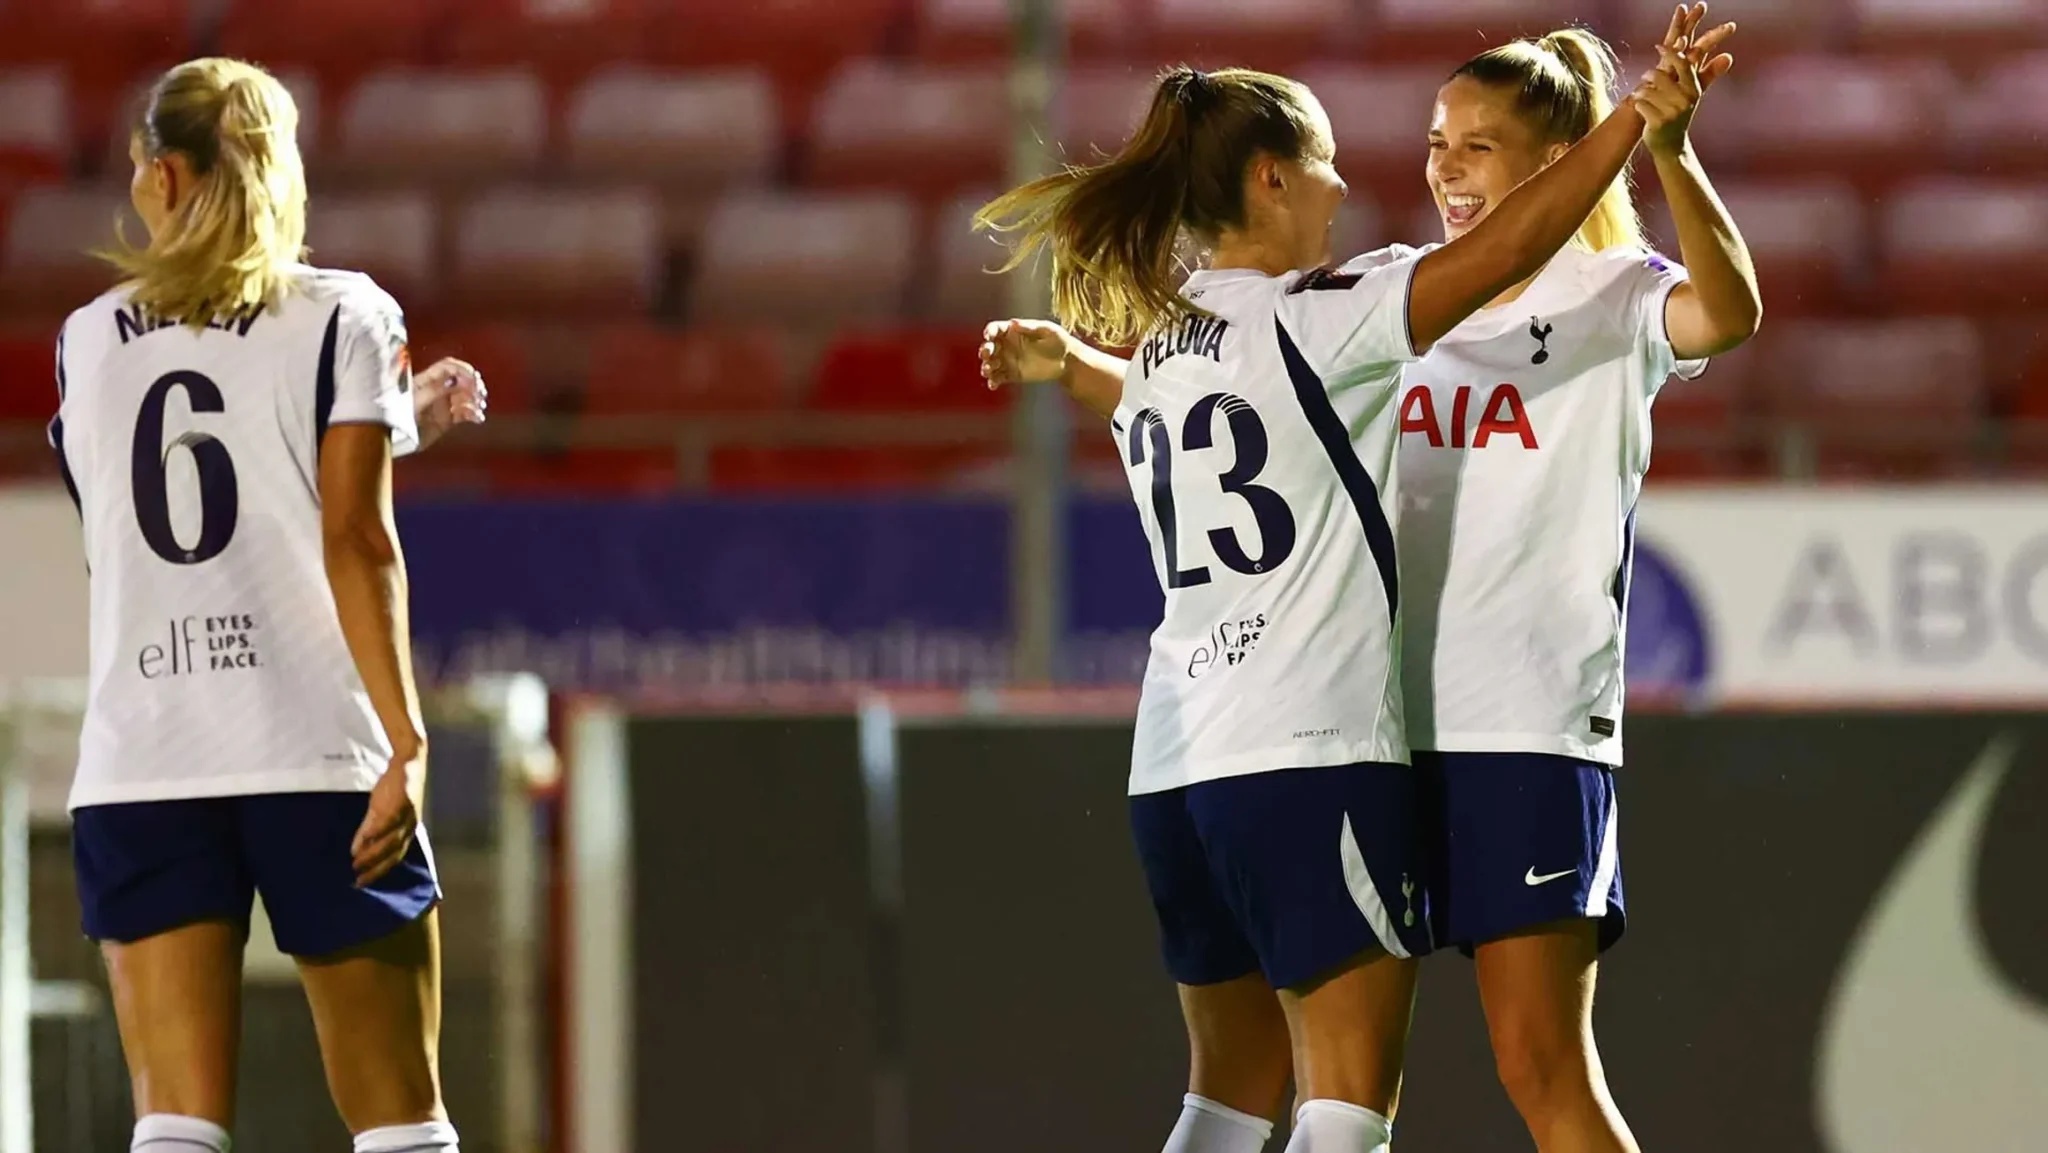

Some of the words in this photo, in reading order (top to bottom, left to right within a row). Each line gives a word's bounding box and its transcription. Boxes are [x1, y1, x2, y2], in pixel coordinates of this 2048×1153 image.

[1142, 312, 1229, 381] PELOVA
[131, 369, 239, 565] 6
[1400, 382, 1540, 450] AIA
[1129, 392, 1297, 589] 23
